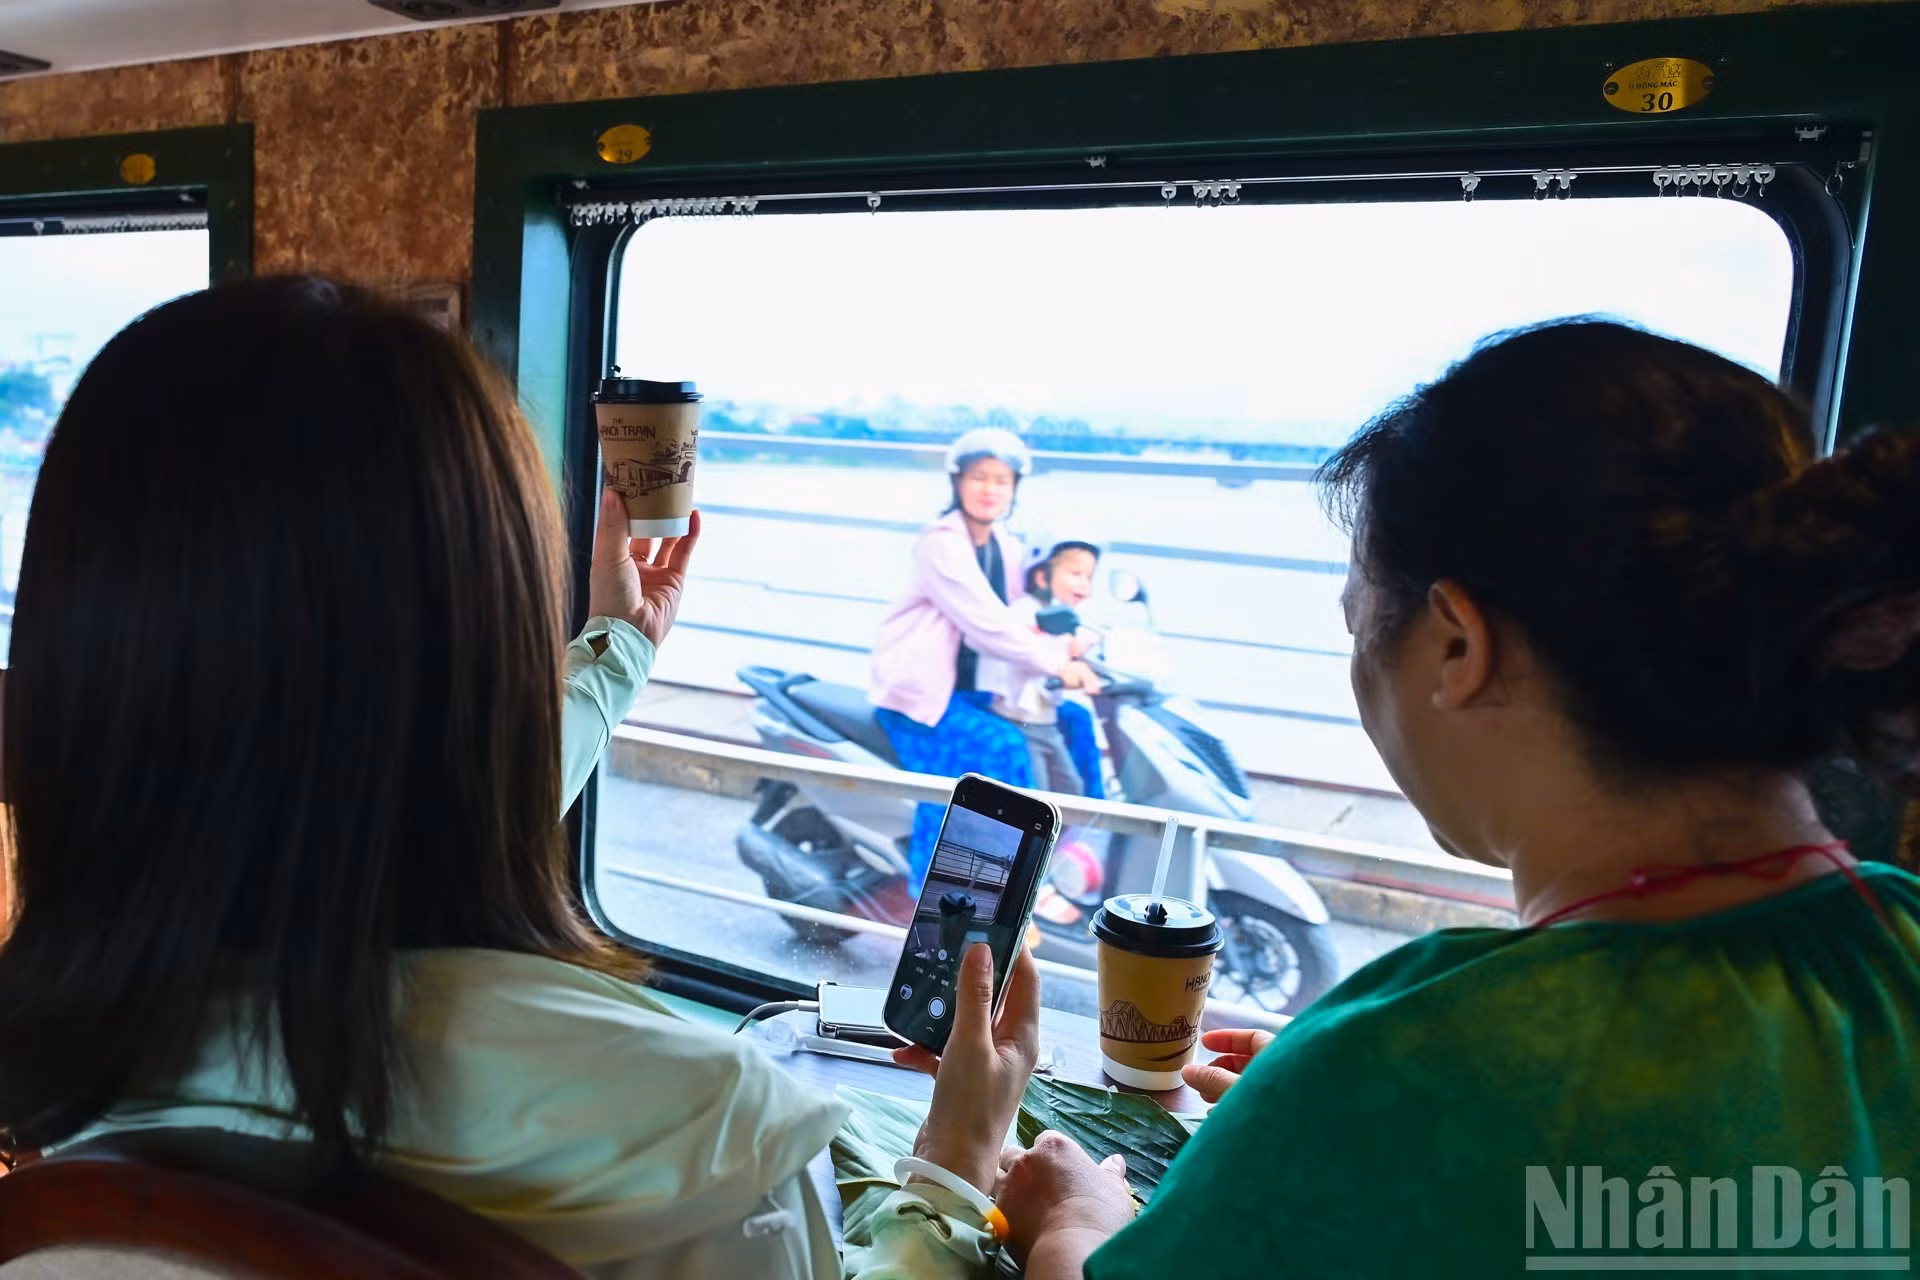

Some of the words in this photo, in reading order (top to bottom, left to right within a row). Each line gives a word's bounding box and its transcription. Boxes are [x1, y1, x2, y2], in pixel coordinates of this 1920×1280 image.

[1640, 92, 1673, 112] 30
[615, 149, 633, 162] 29
[621, 425, 656, 439] TRAIN
